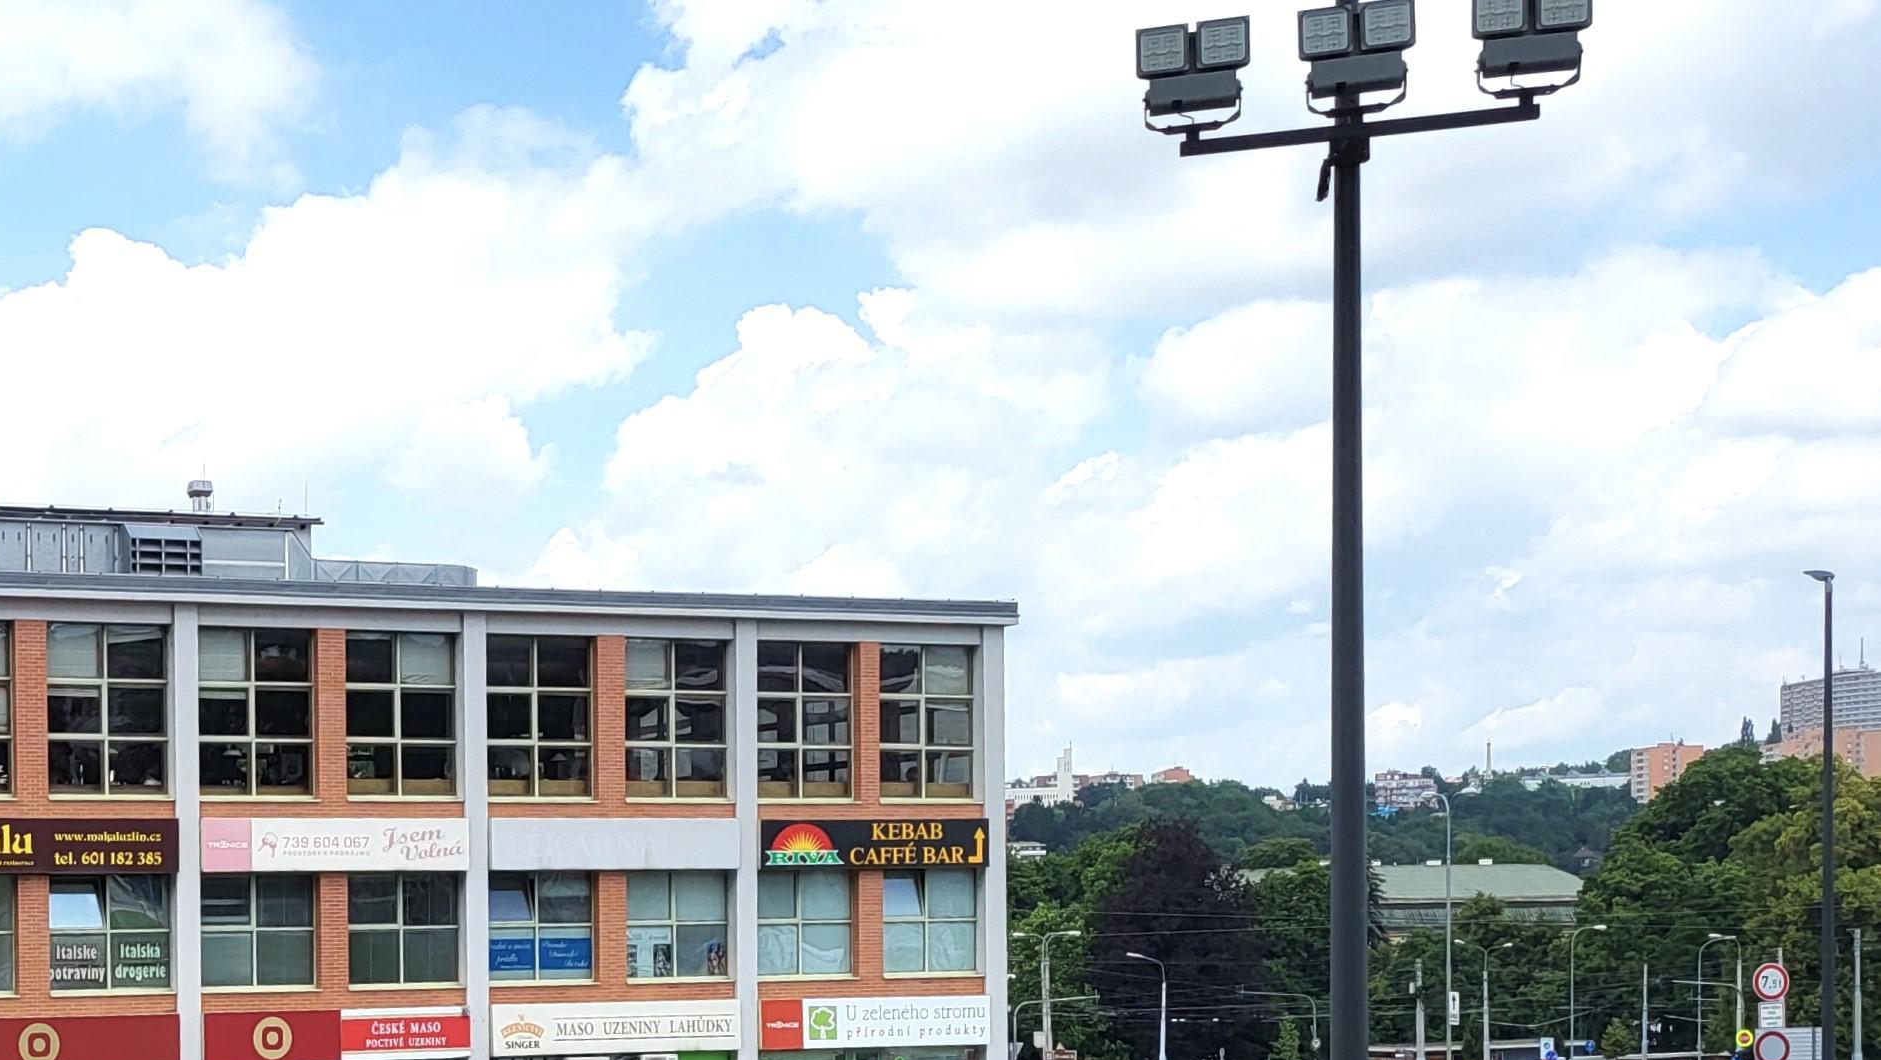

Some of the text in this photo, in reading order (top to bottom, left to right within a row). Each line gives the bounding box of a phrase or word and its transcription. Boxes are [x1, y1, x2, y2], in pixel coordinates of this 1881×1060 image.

[54, 831, 162, 844] www.makaluzlin.cz
[871, 822, 944, 841] KEBAB
[207, 839, 249, 849] TRŽNICE
[283, 836, 370, 848] 739 604 067
[382, 828, 444, 852] Jsem
[400, 840, 464, 861] Volná
[768, 851, 841, 865] RIVA
[850, 842, 964, 864] CAFFÉ BAR
[54, 852, 163, 865] tel. 601 182 385
[56, 944, 98, 960] Italské
[120, 943, 161, 958] Italská
[114, 963, 167, 981] drogerie
[846, 1004, 986, 1021] U zeleného stromu
[371, 1020, 441, 1035] ČESKÉ MASO
[556, 1016, 733, 1036] MASO UZENINY LAHŮDKY
[846, 1024, 986, 1040] přírodní produkty
[366, 1036, 447, 1048] POCTIVÉ UZENINY
[505, 1040, 540, 1049] SINGER
